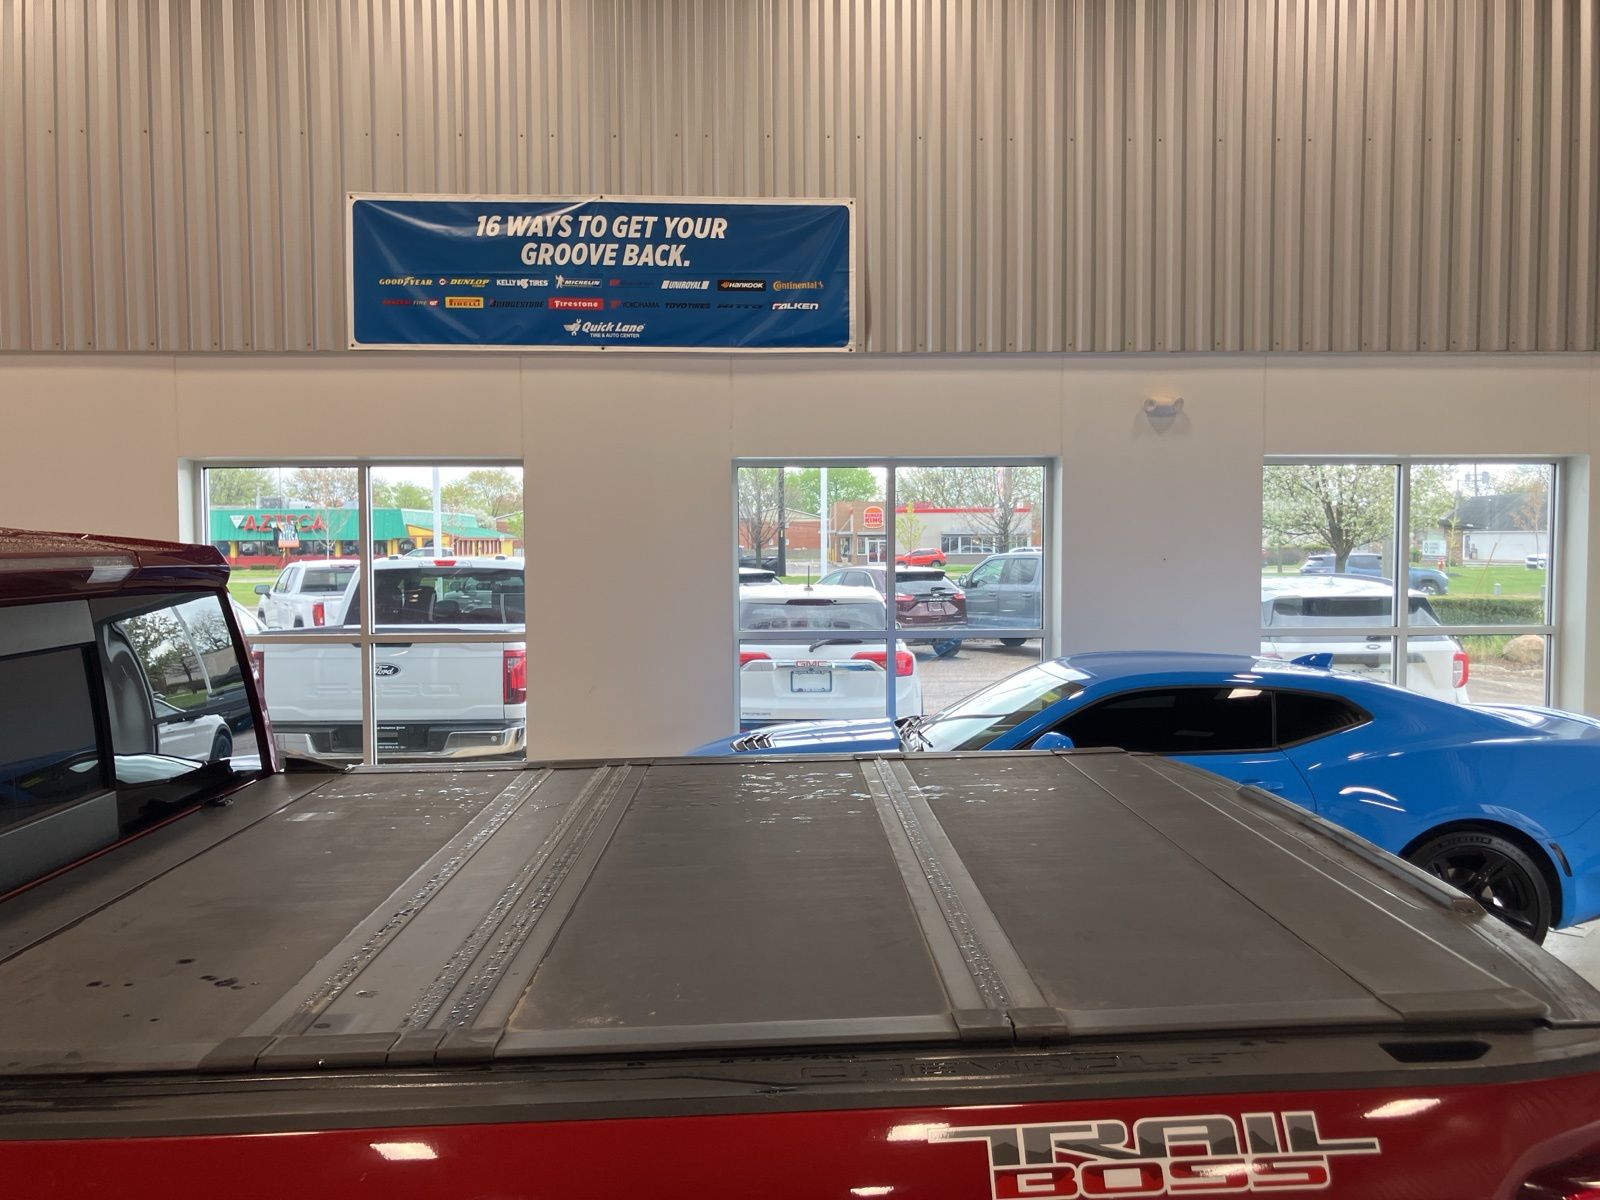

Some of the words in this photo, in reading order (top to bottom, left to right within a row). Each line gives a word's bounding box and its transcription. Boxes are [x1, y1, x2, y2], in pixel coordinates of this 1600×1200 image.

[476, 215, 501, 237] 16
[507, 215, 574, 238] WAYS
[578, 215, 608, 238] TO
[612, 216, 659, 239] GET
[664, 217, 728, 239] YOUR
[520, 242, 619, 267] GROOVE
[622, 244, 691, 267] BACK.
[378, 277, 433, 286] GOODYEAR
[668, 280, 703, 290] UNIROYAL
[773, 280, 818, 291] Continental
[554, 300, 599, 308] Firestone
[772, 302, 819, 310] FALKEN
[581, 321, 614, 334] Quick
[615, 322, 645, 333] Lane
[796, 660, 829, 668] GMC
[928, 1111, 1381, 1167] TRAIL
[991, 1154, 1332, 1200] BOSS
